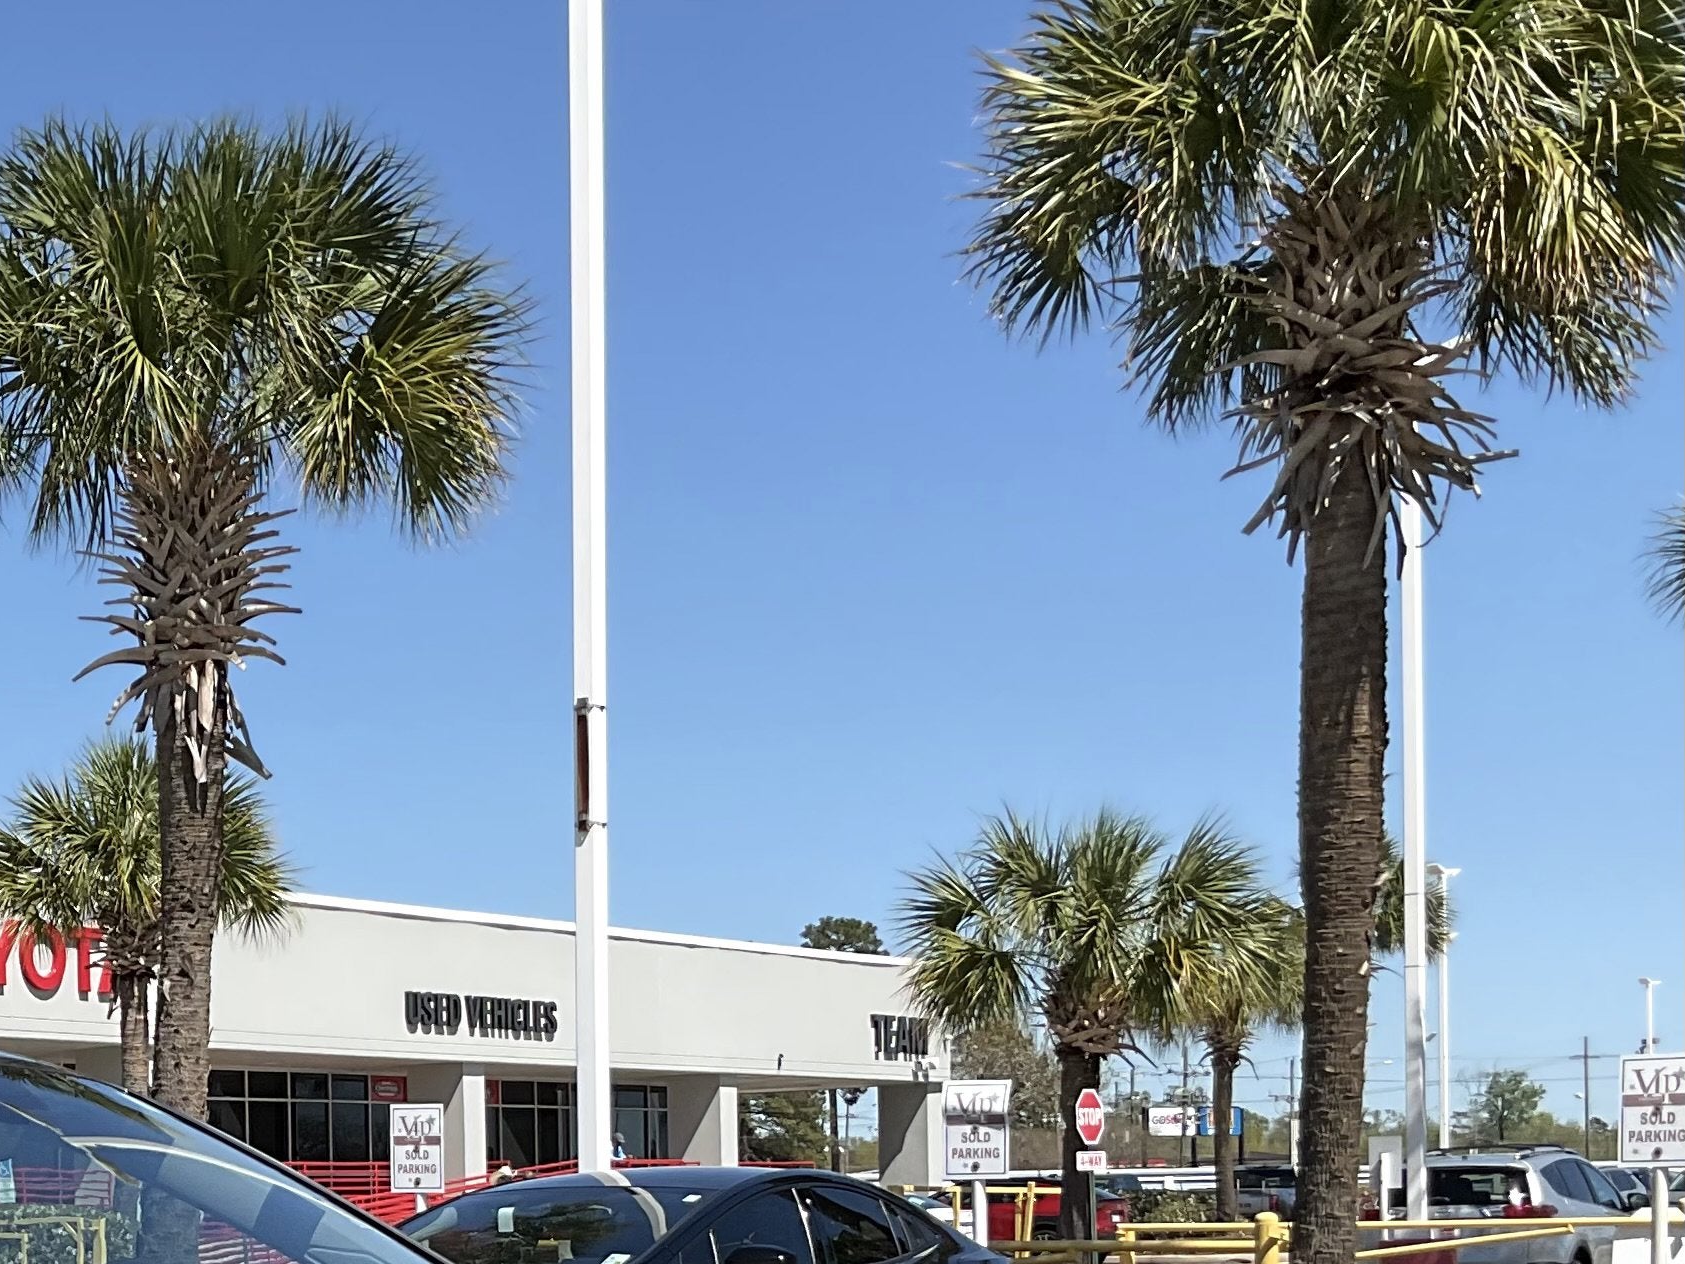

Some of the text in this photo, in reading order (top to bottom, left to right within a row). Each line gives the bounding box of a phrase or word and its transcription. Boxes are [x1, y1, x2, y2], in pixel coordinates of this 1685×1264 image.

[405, 991, 558, 1034] USED VEHICLES
[870, 1014, 929, 1055] TEAM
[1078, 1107, 1102, 1126] STOP
[1640, 1111, 1676, 1125] SOLD
[961, 1131, 991, 1143] SOLD
[1628, 1129, 1685, 1143] PARKING
[405, 1149, 429, 1160] SOLD
[951, 1147, 1001, 1159] PARKING
[1081, 1155, 1102, 1167] 4-WAY
[397, 1163, 437, 1175] PARKING
